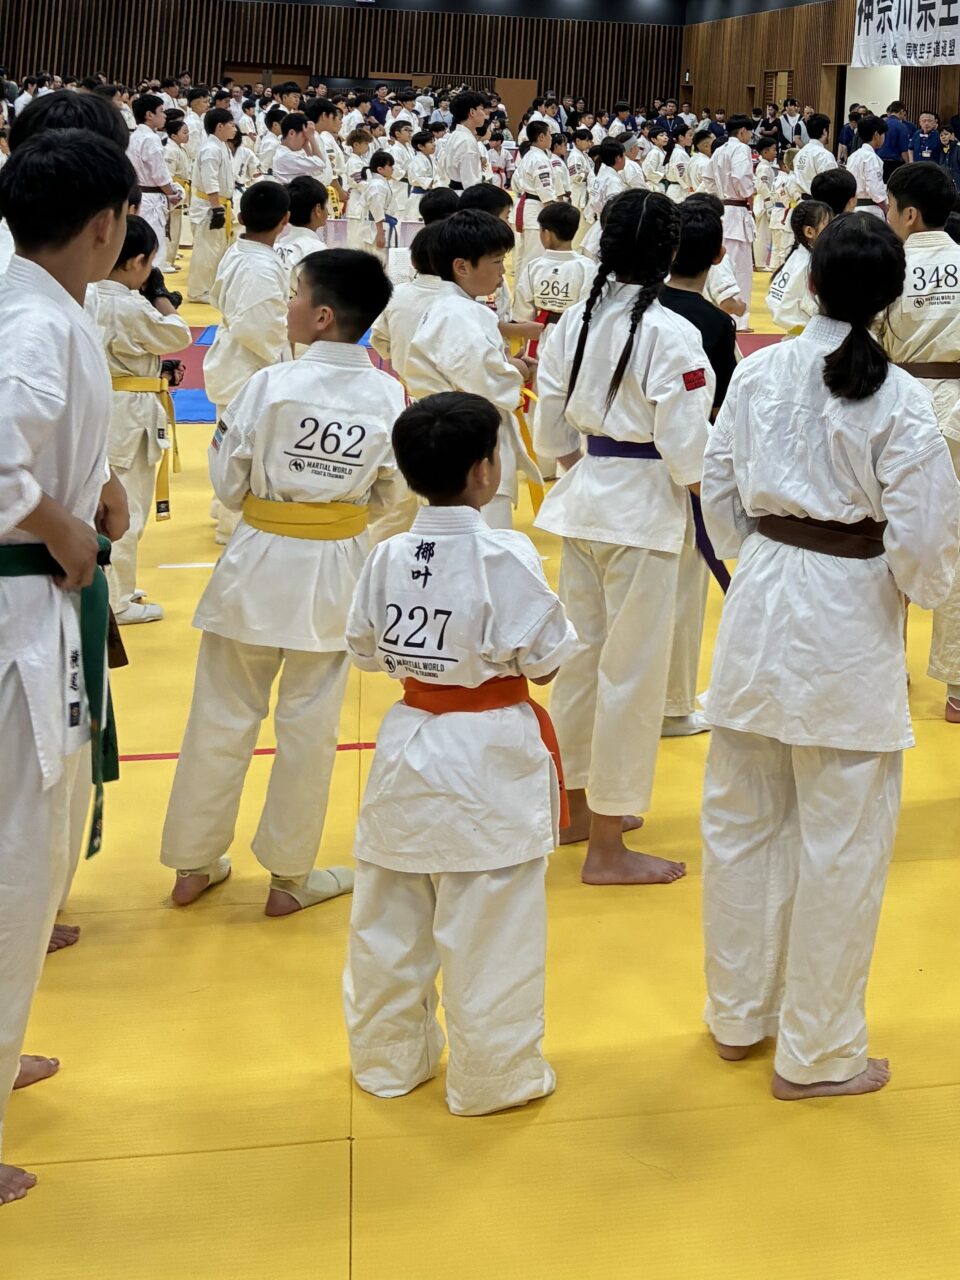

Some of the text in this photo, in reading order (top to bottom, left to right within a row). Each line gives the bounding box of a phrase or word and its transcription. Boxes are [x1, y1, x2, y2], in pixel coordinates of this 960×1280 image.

[913, 264, 958, 291] 348
[540, 280, 569, 298] 264
[294, 417, 366, 458] 262
[307, 461, 353, 475] MARTIAL WORLD
[383, 603, 452, 651] 227
[396, 659, 445, 673] MARTIAL WORLD
